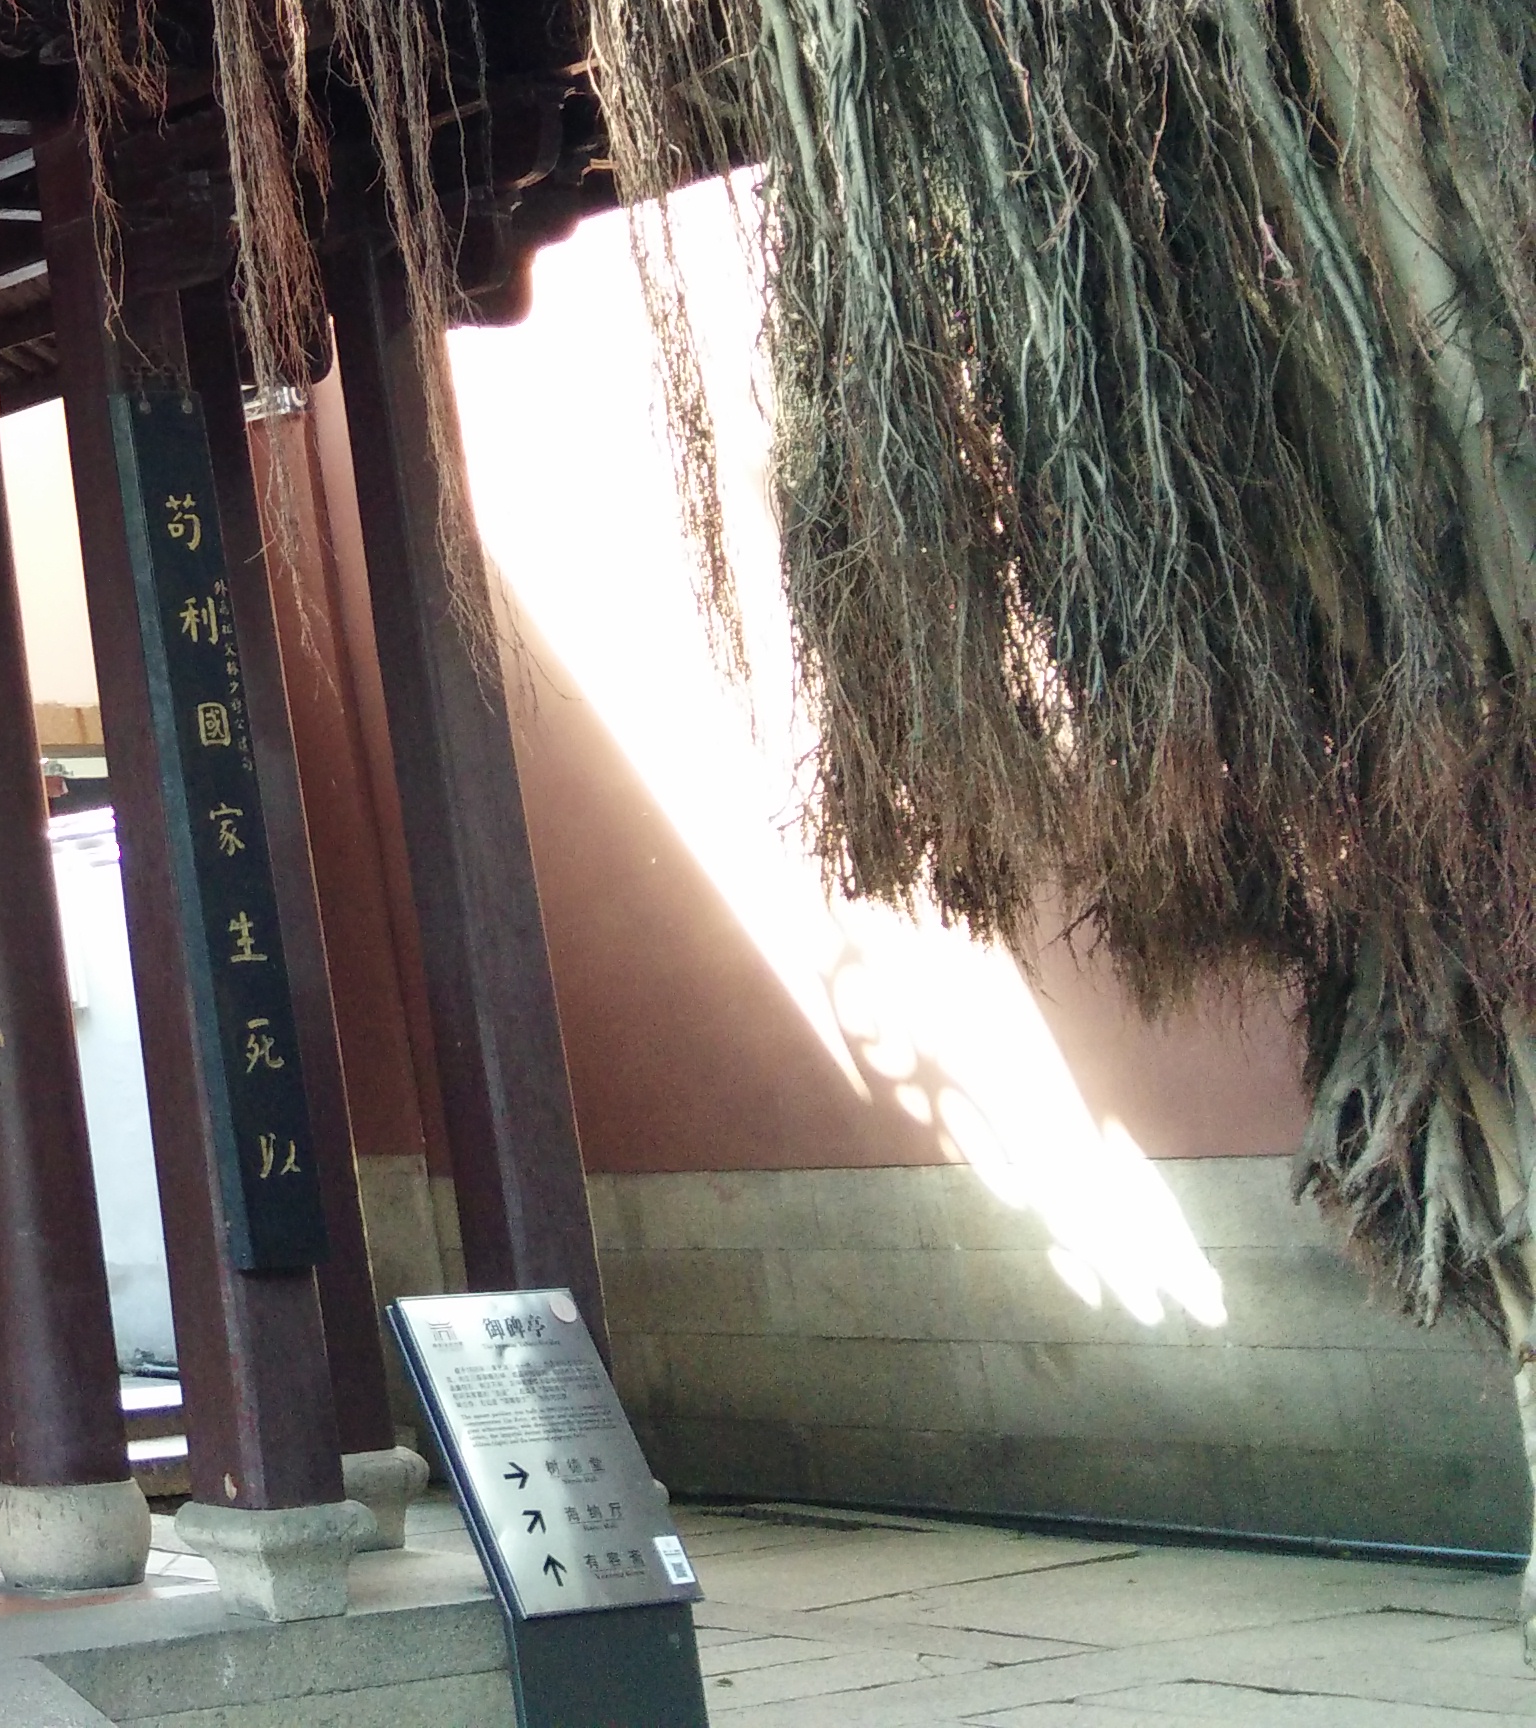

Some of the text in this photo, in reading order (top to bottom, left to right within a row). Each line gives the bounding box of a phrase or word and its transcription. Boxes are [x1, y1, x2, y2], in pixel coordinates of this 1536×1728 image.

[164, 493, 302, 1179] 苟利國家生死以
[482, 1314, 547, 1341] 御碑亭
